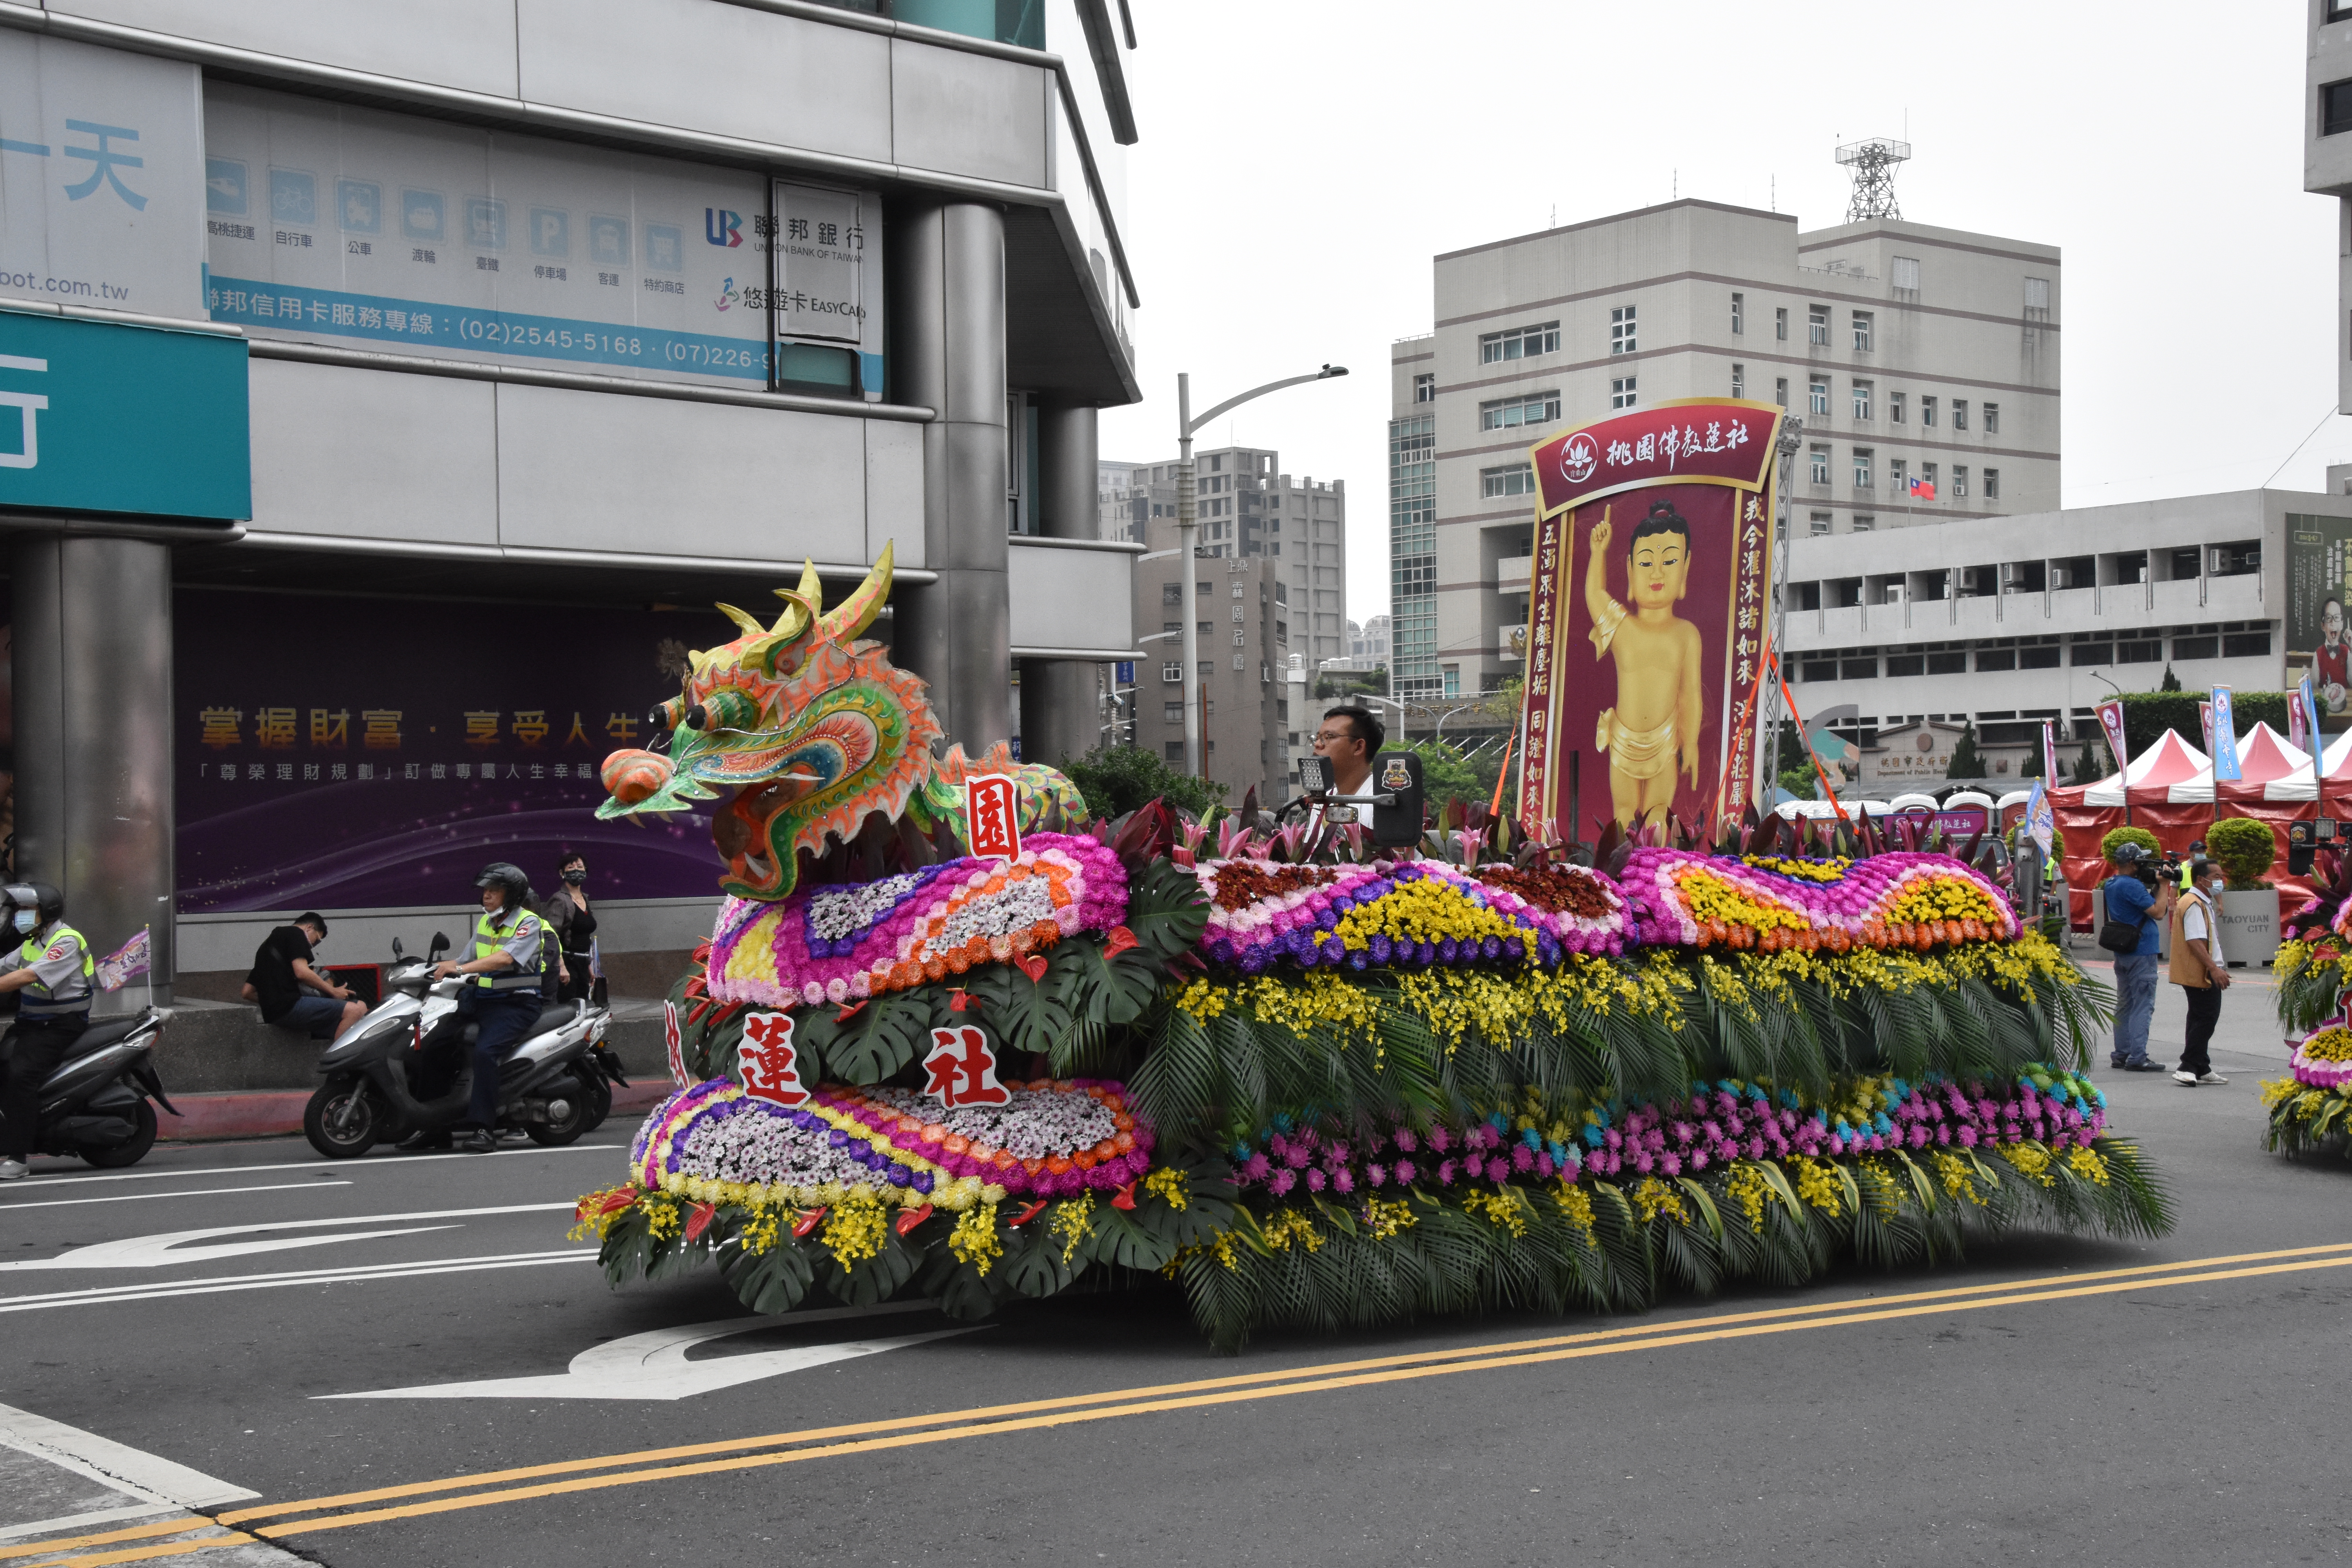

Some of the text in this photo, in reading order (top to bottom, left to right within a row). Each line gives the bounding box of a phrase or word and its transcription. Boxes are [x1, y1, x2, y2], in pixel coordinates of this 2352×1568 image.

[276, 231, 312, 247] 自行車
[754, 214, 863, 250] 聯邦銀行
[348, 241, 371, 255] 公車
[412, 249, 436, 264] 渡輪
[754, 243, 863, 263] UNON BANK OF TAIWAN
[476, 257, 499, 272] 臺鐵
[534, 265, 566, 281] 停車場
[598, 272, 619, 287] 客運
[644, 279, 684, 294] 特約商店
[744, 287, 807, 312] 悠遊卡
[1607, 419, 1748, 472] 桃園佛教蓮社
[1736, 495, 1765, 686] 我今灌沐諸如來
[201, 762, 592, 781] 「尊榮理財規劃」訂做專屬人生幸福
[970, 779, 1019, 864] 園
[2222, 915, 2269, 924] TAOYUAN
[2247, 924, 2269, 933] CITY
[739, 1017, 807, 1104] 蓮
[925, 1029, 1007, 1108] 社
